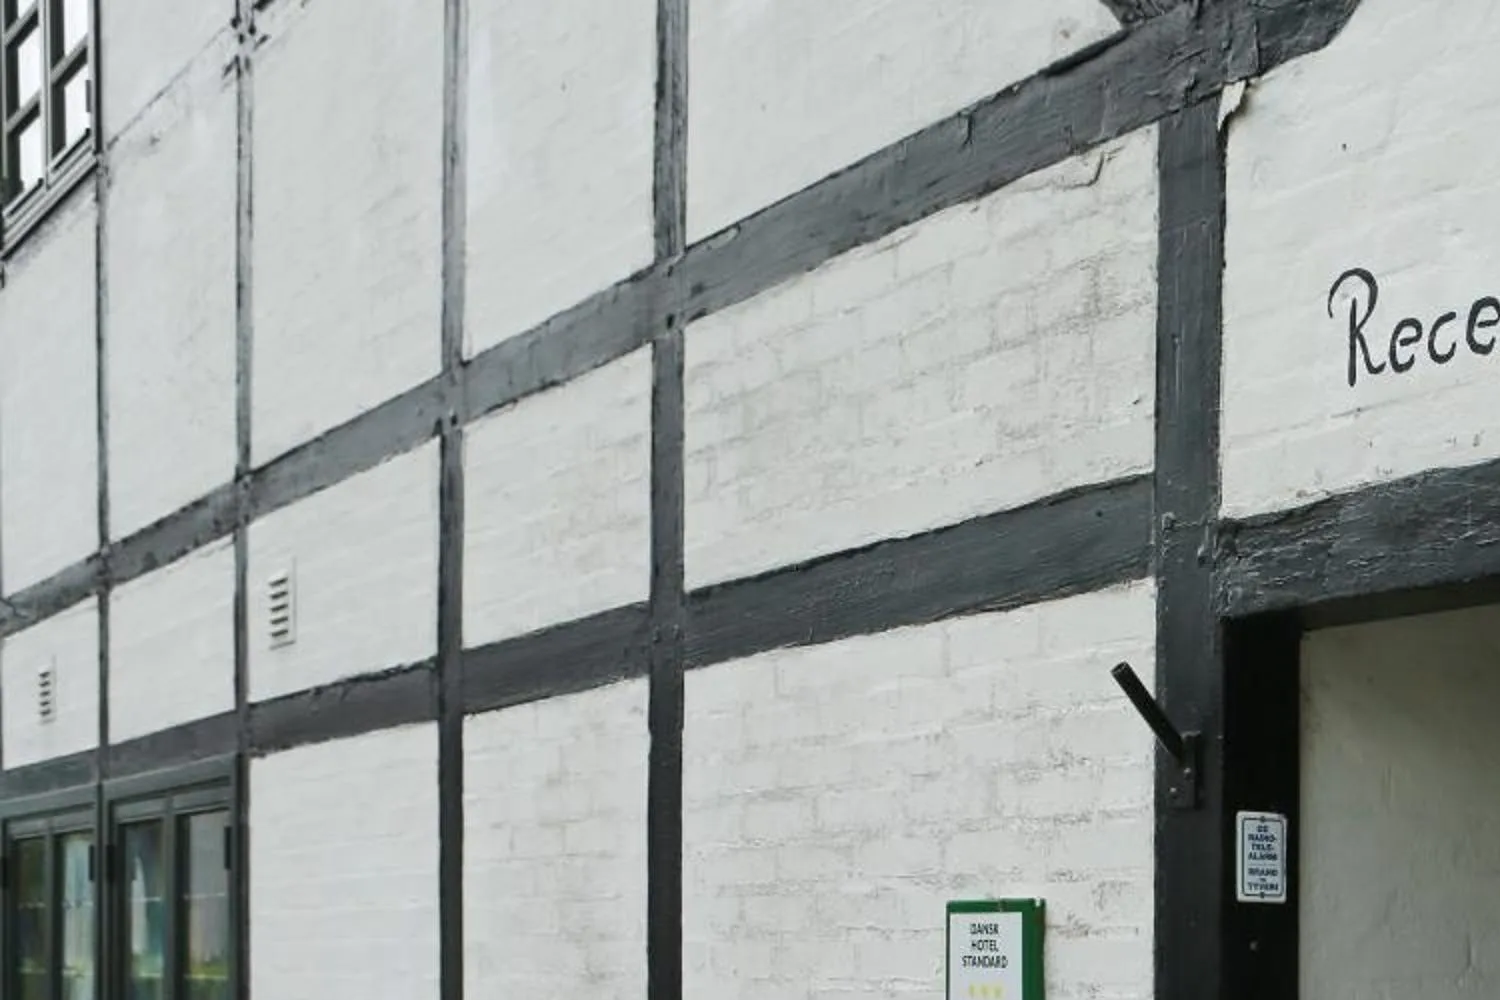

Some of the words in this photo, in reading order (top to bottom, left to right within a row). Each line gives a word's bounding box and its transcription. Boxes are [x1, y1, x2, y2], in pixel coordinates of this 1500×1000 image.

[969, 923, 999, 936] DANSK
[971, 939, 999, 952] HOTEL
[962, 955, 1009, 969] STANDARD
